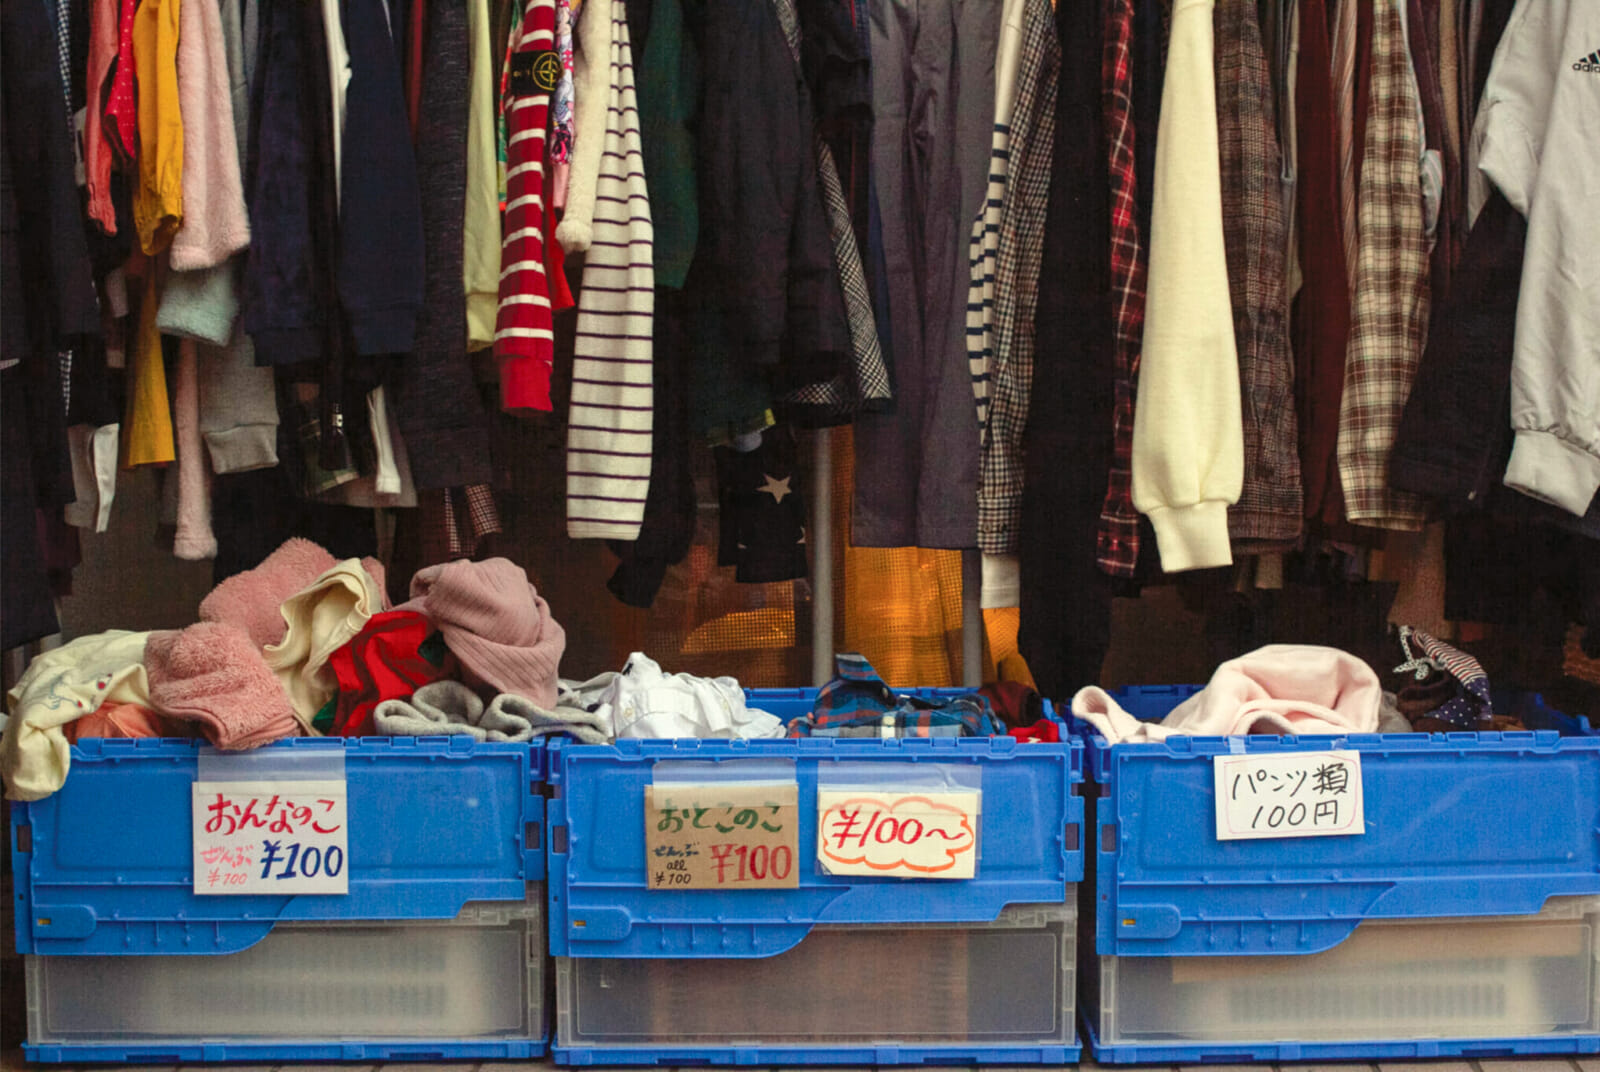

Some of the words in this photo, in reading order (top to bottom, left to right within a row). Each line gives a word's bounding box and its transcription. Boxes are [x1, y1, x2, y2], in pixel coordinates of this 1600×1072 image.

[1232, 762, 1349, 801] パンツ類
[205, 793, 341, 836] おんなのこ
[657, 799, 783, 834] おとこのこ
[1251, 799, 1338, 829] 100円
[200, 844, 254, 868] ぜんぶ
[260, 840, 343, 880] ¥100
[666, 859, 688, 871] all
[709, 843, 792, 884] ¥100
[206, 867, 248, 888] ¥100
[654, 872, 692, 886] ¥100
